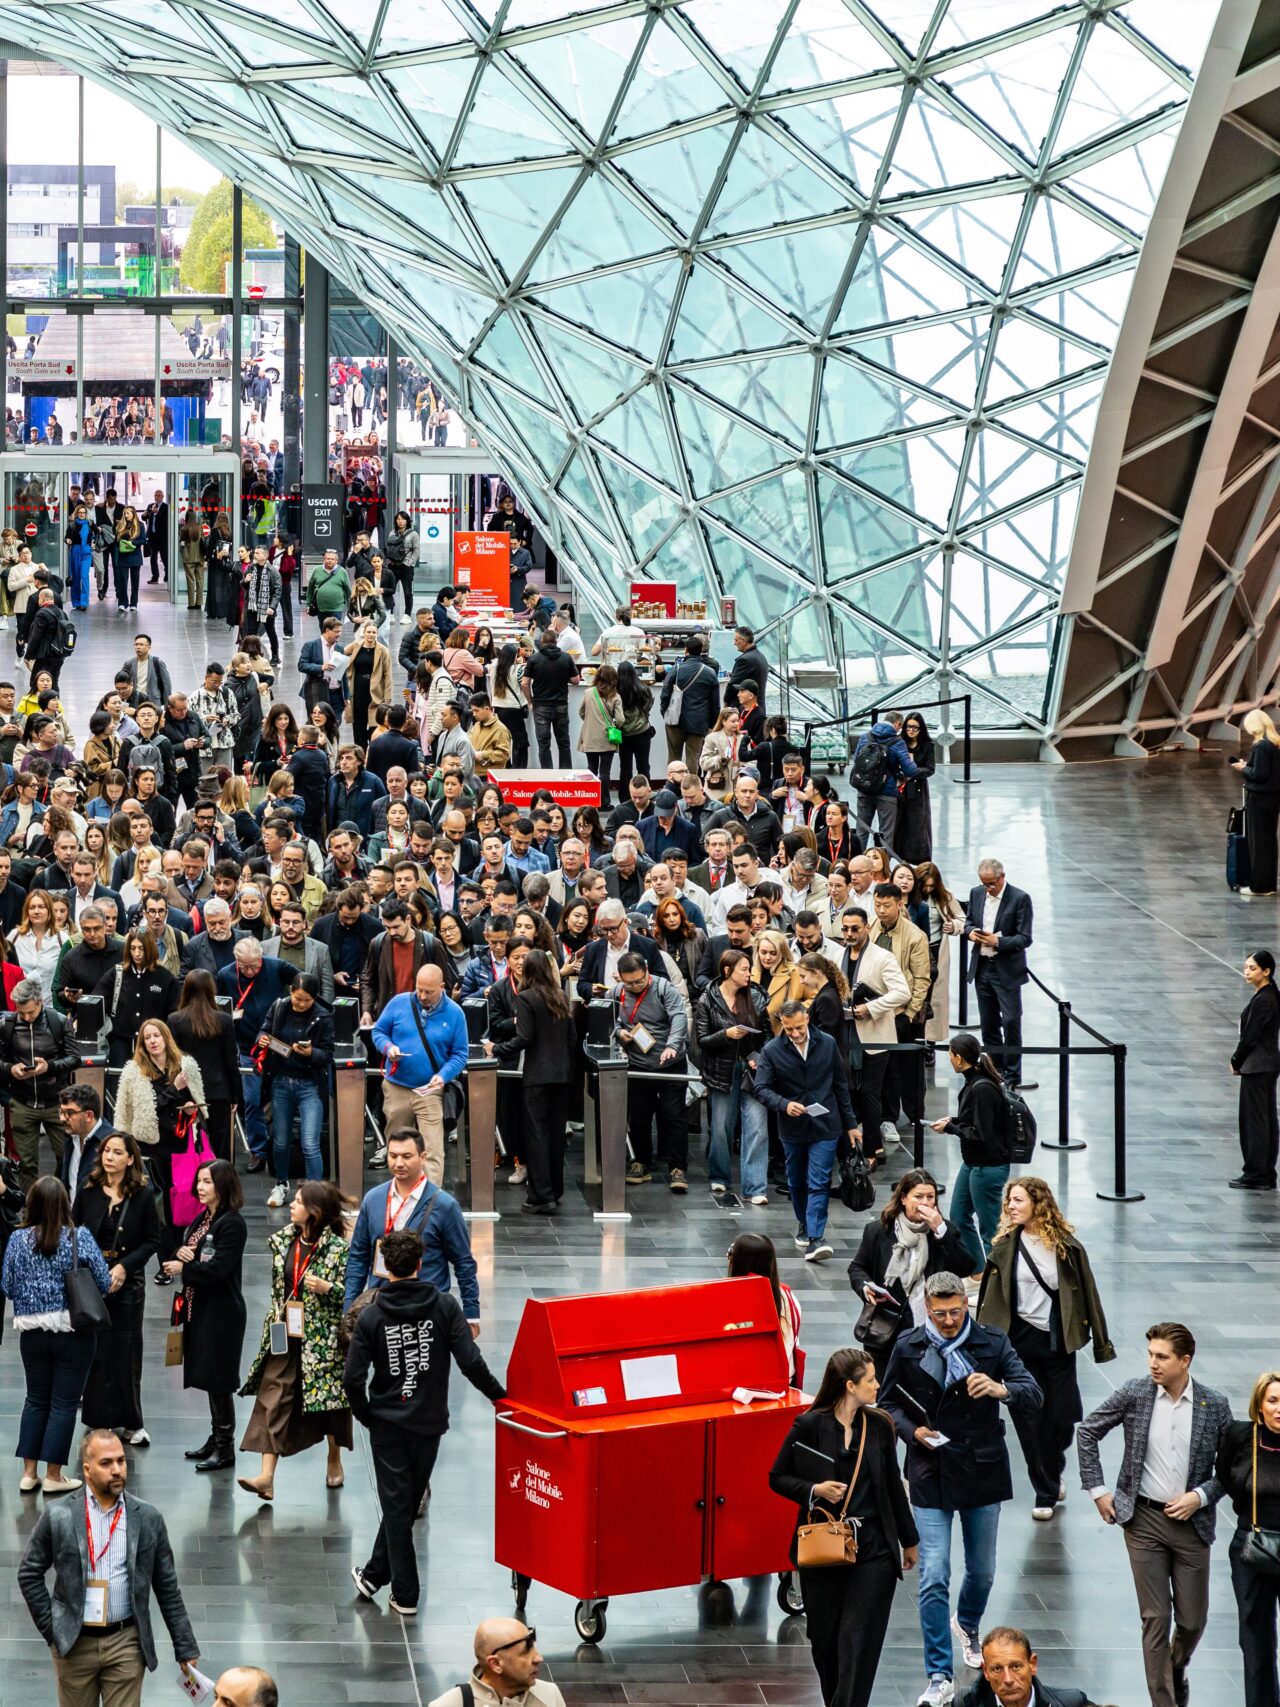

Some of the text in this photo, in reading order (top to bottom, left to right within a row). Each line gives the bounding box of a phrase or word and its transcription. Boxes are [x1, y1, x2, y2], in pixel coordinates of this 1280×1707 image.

[307, 498, 339, 507] USCITA
[314, 508, 332, 516] EXIT
[401, 1323, 418, 1347] del
[417, 1319, 434, 1371] Salone
[384, 1324, 403, 1376] Milano
[525, 1459, 551, 1480] Salone
[524, 1487, 550, 1509] Milano
[525, 1474, 564, 1501] del Mobile.
